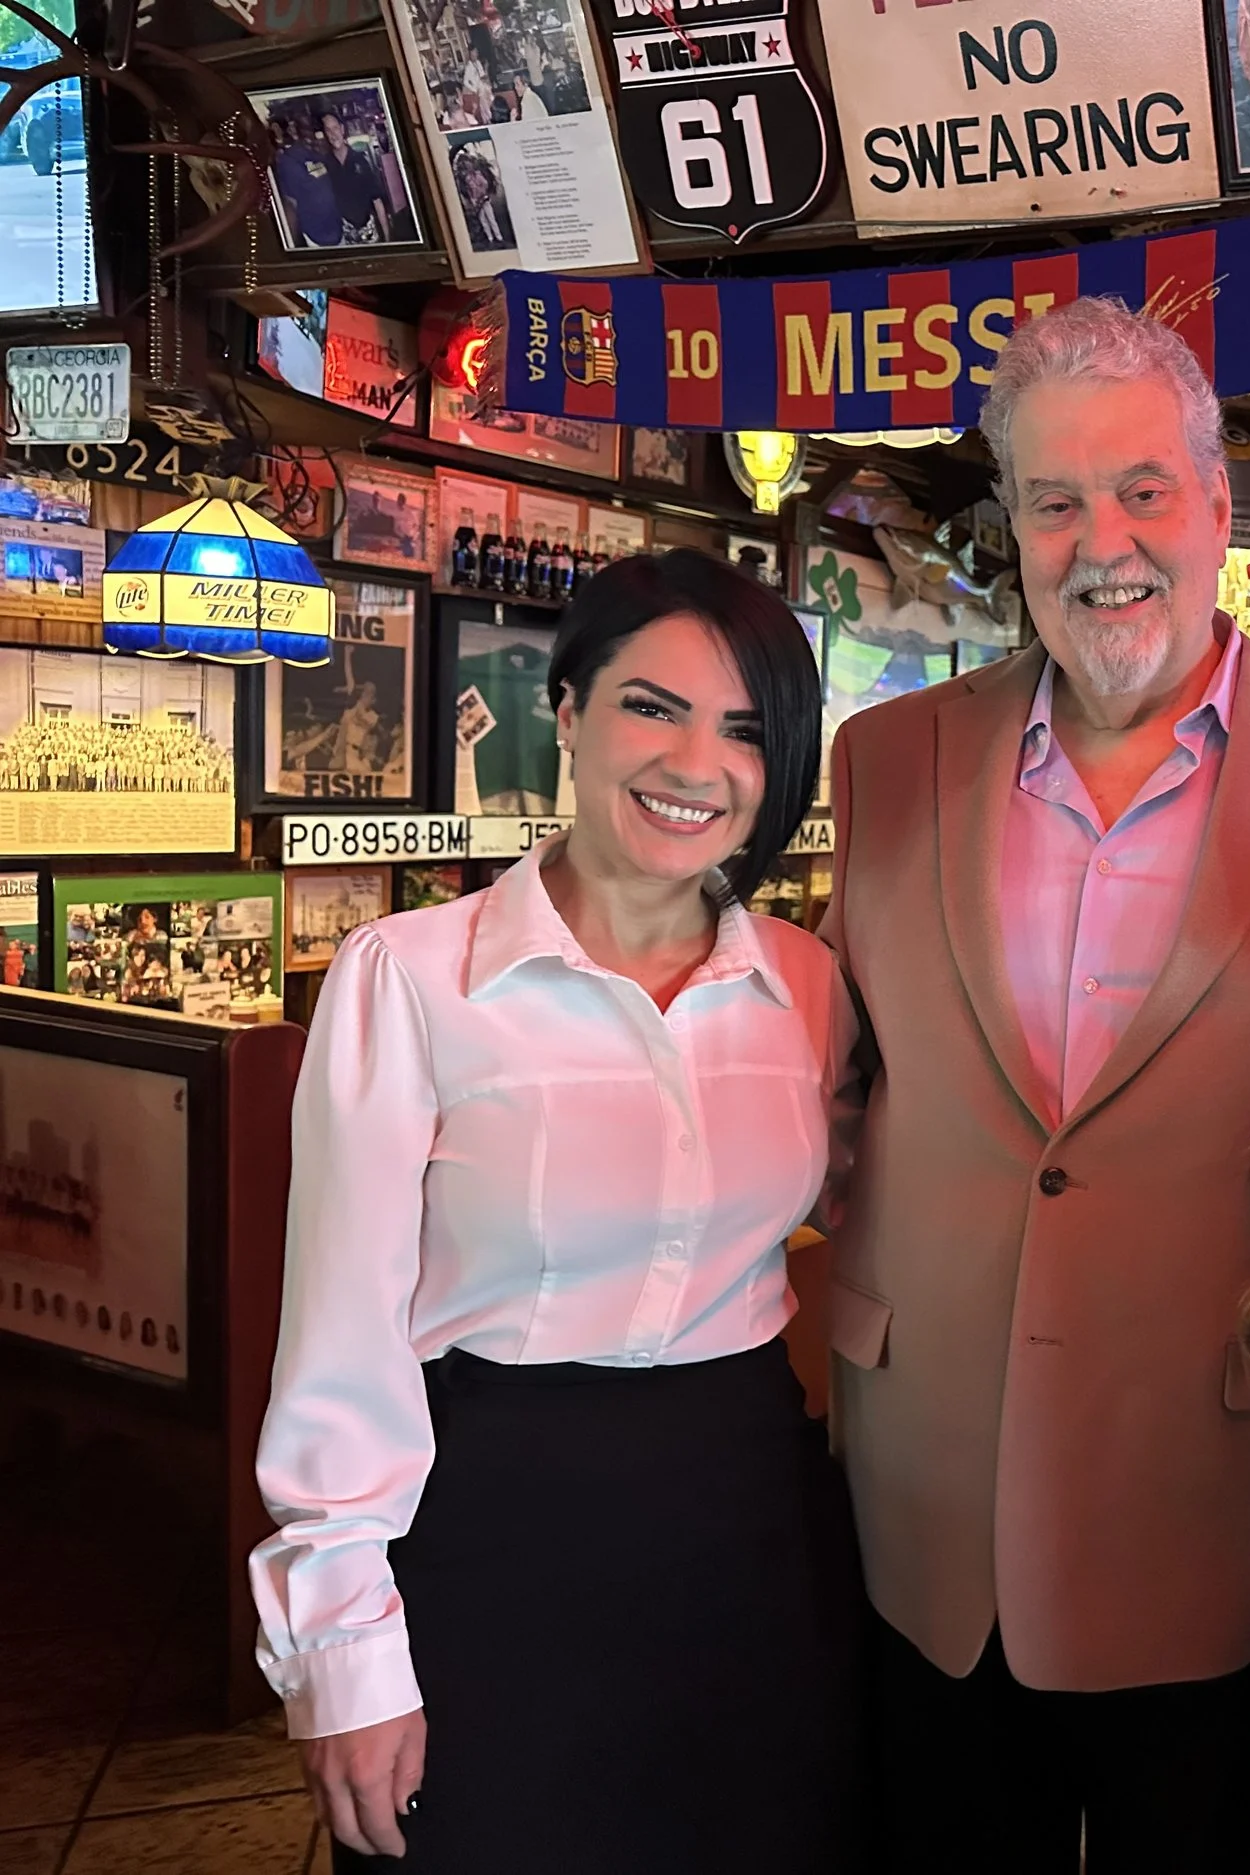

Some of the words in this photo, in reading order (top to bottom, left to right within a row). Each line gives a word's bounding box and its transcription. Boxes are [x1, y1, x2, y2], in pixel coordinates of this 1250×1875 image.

[644, 31, 757, 73] HIGHWAY
[958, 19, 1058, 91] NO
[660, 94, 773, 210] 61
[863, 92, 1191, 194] SWEARING
[54, 349, 121, 367] GEORGIA
[527, 297, 549, 382] BARÇA
[667, 329, 719, 380] 10
[784, 292, 1055, 396] MESS
[18, 372, 115, 420] RBC2381
[119, 588, 148, 610] Lite
[190, 581, 307, 607] MILLER
[205, 602, 296, 627] TIME!
[304, 773, 384, 798] FISH!
